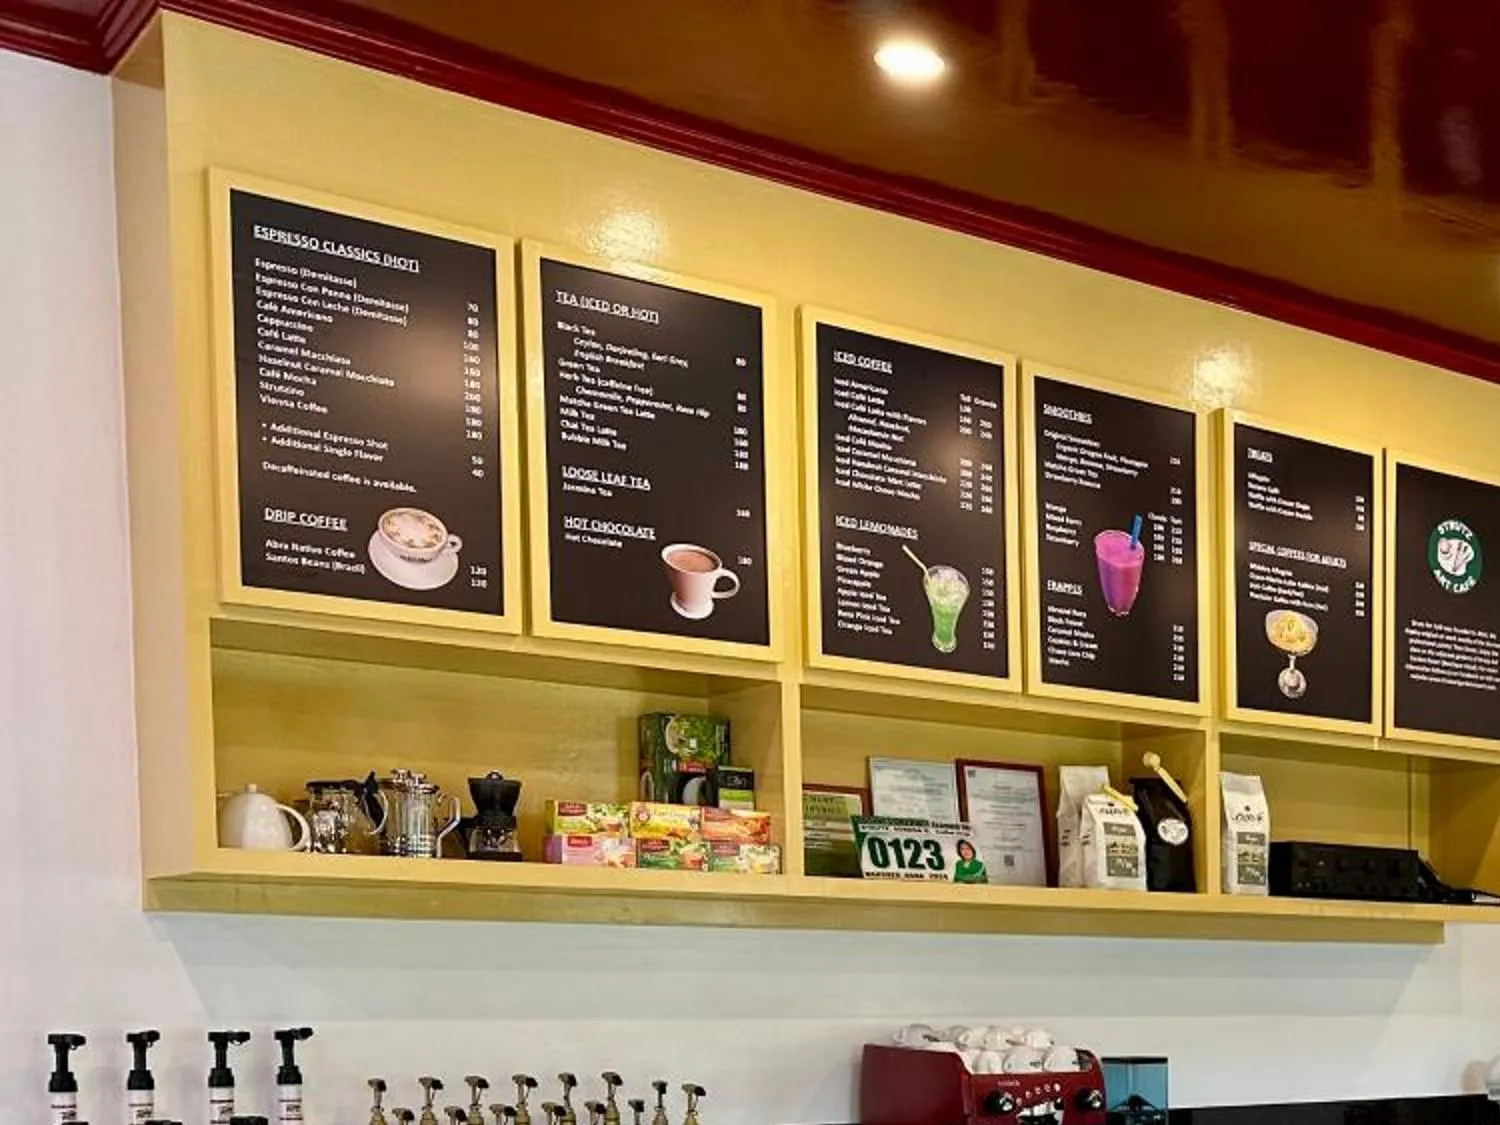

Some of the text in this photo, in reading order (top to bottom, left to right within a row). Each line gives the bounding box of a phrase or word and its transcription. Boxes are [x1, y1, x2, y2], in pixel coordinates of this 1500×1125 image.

[253, 224, 320, 251] ESPRESSO
[323, 239, 380, 265] CLASSICS
[254, 256, 298, 277] Espresso
[255, 271, 298, 291] Espresso
[255, 285, 299, 304] Espresso
[280, 303, 333, 323] Americano
[257, 339, 299, 356] Caramel
[303, 361, 344, 378] Caramel
[296, 399, 328, 414] Coffee
[269, 421, 321, 440] Additional
[323, 430, 365, 447] Espresso
[270, 434, 321, 453] Additional
[332, 471, 361, 485] coffee
[561, 464, 599, 482] LOOSE
[629, 476, 651, 491] TEA
[264, 506, 348, 532] DRIP COFFEE
[590, 519, 656, 540] CHOCOLATE
[265, 551, 299, 566] Santos
[324, 546, 355, 559] Coffee
[867, 836, 946, 871] 0123
